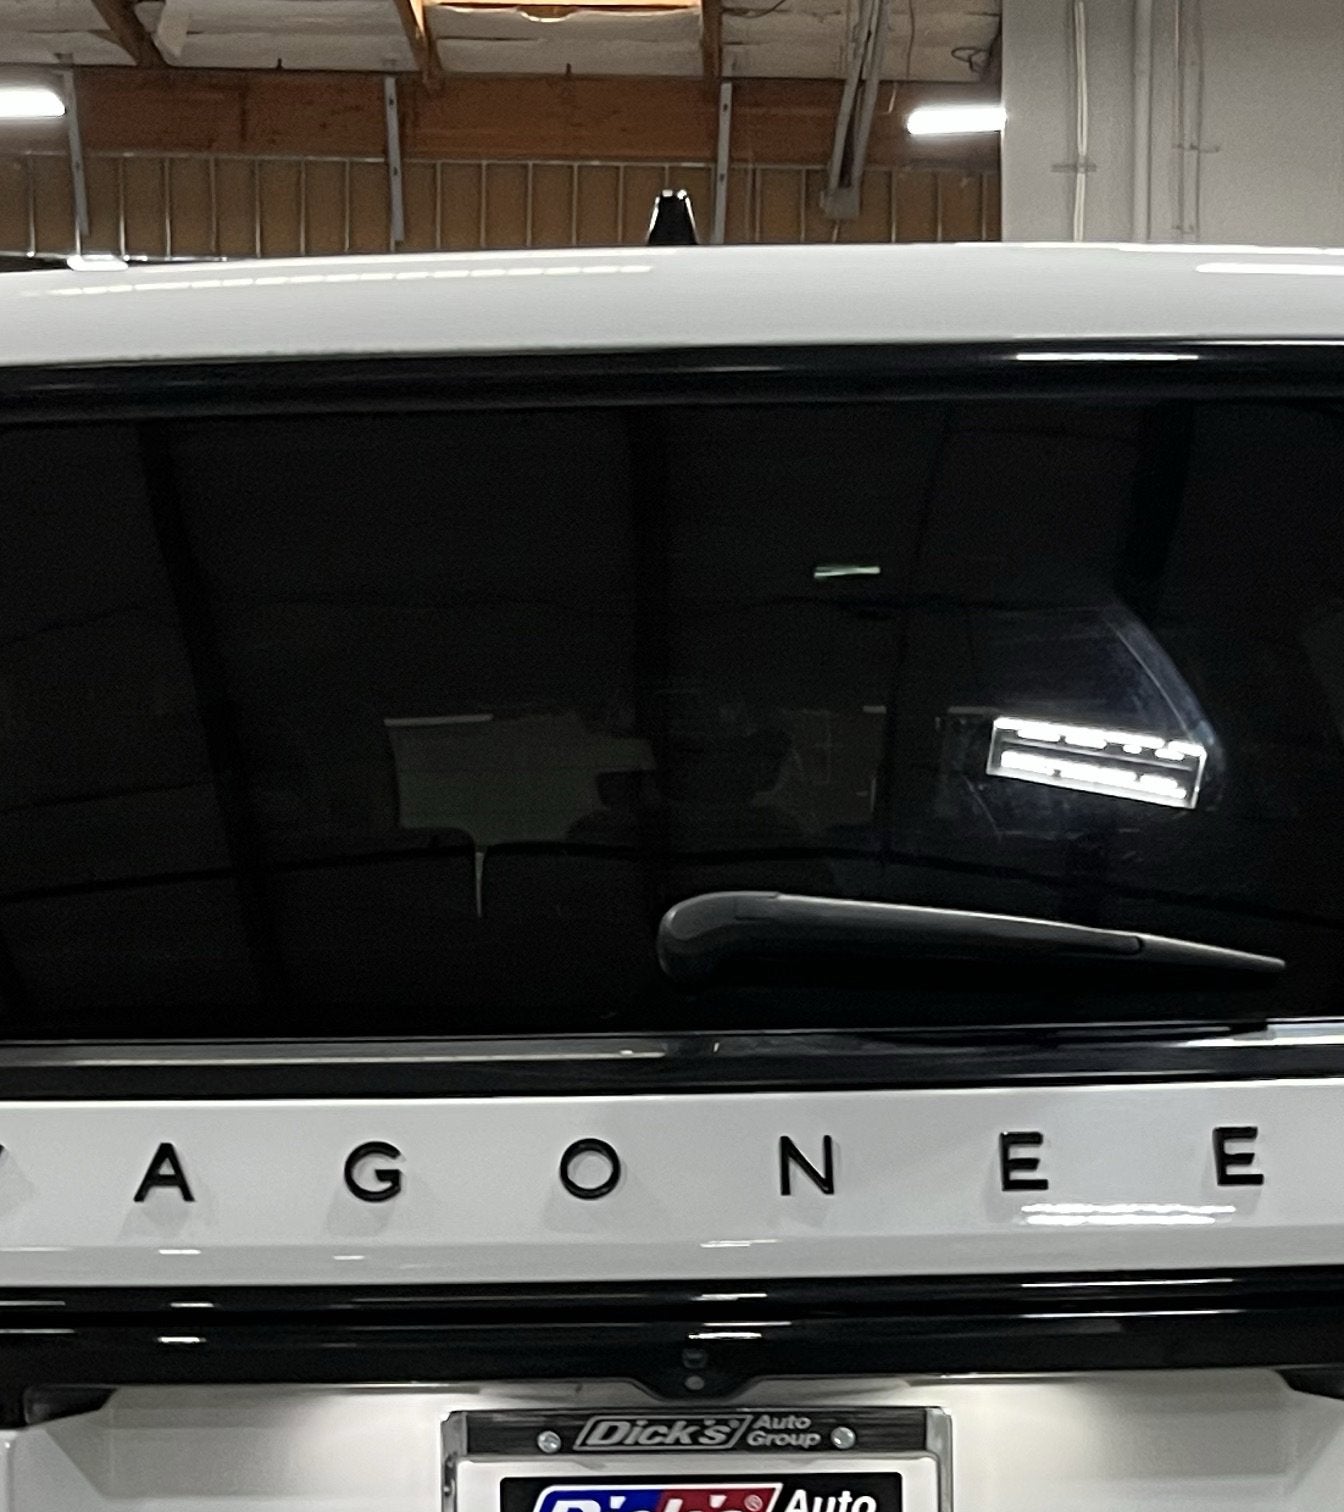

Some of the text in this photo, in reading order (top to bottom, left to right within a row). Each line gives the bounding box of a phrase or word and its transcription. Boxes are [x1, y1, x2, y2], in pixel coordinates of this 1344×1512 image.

[585, 1414, 812, 1447] Dick's Auto
[746, 1430, 822, 1449] Group
